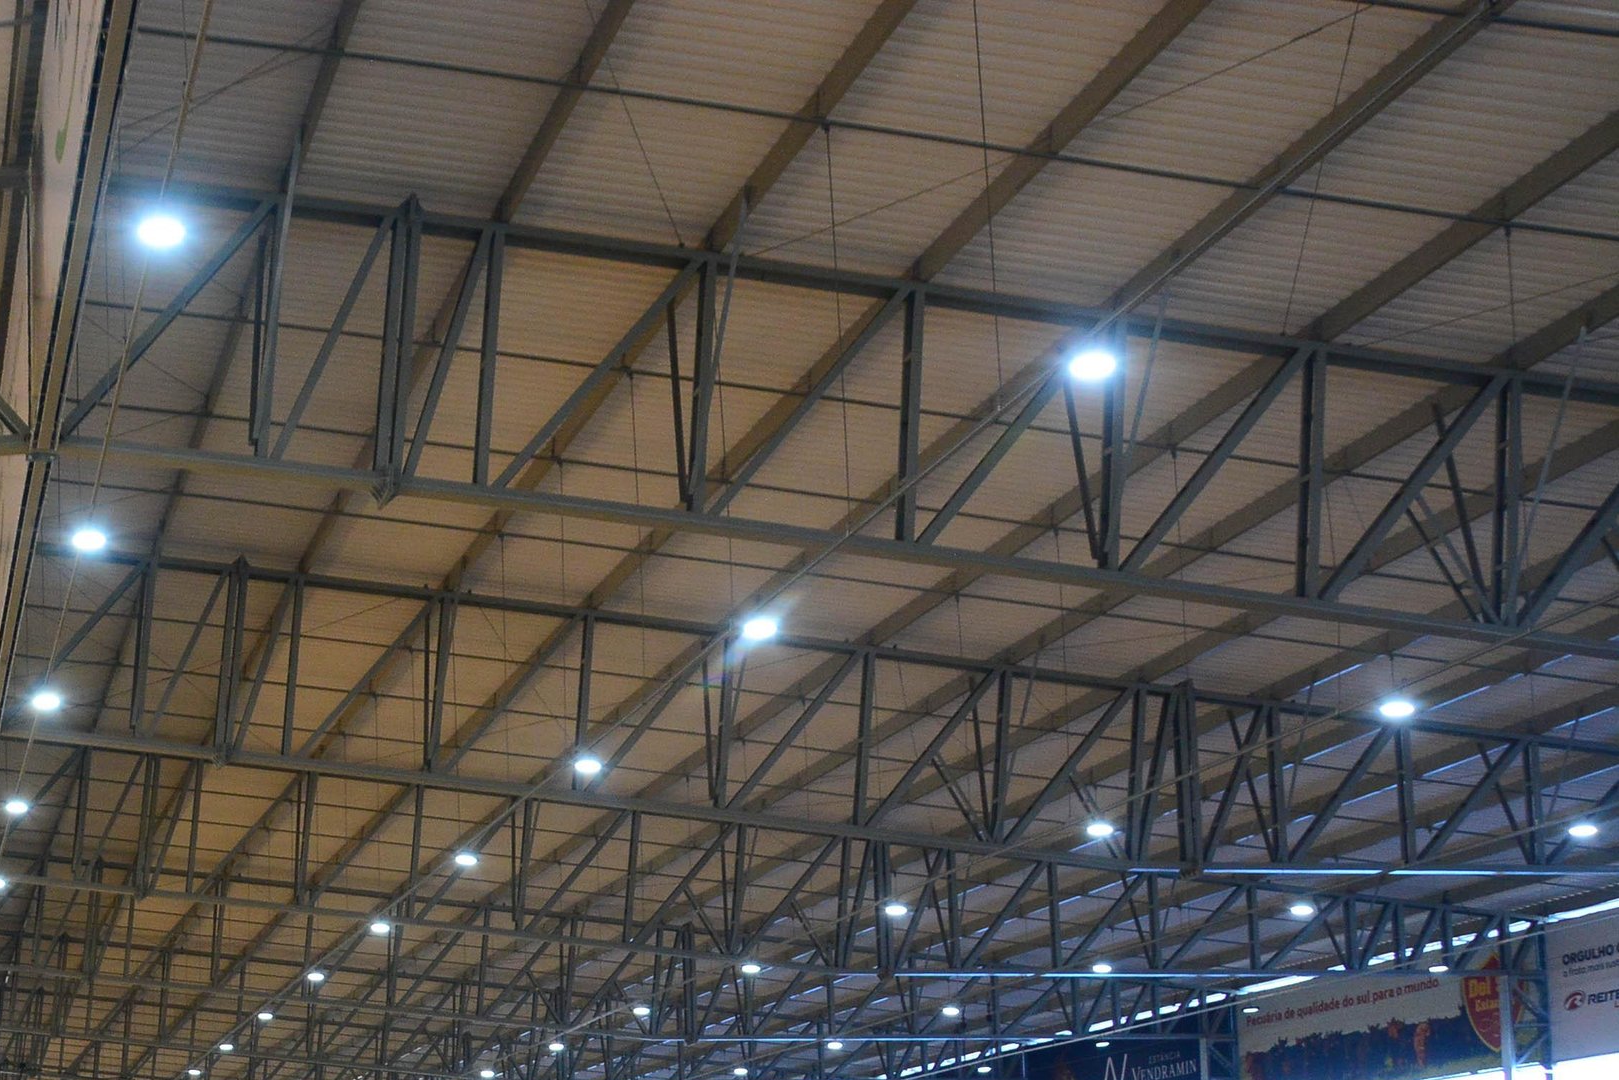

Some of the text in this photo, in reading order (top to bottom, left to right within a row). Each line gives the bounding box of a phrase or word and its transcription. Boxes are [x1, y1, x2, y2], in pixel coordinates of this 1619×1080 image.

[1562, 944, 1614, 965] ORGULHO
[1284, 1008, 1295, 1019] de
[1297, 999, 1340, 1018] qualidade
[1342, 995, 1354, 1008] do
[1356, 992, 1370, 1004] sul
[1373, 988, 1394, 1003] para
[1404, 977, 1439, 994] mundo
